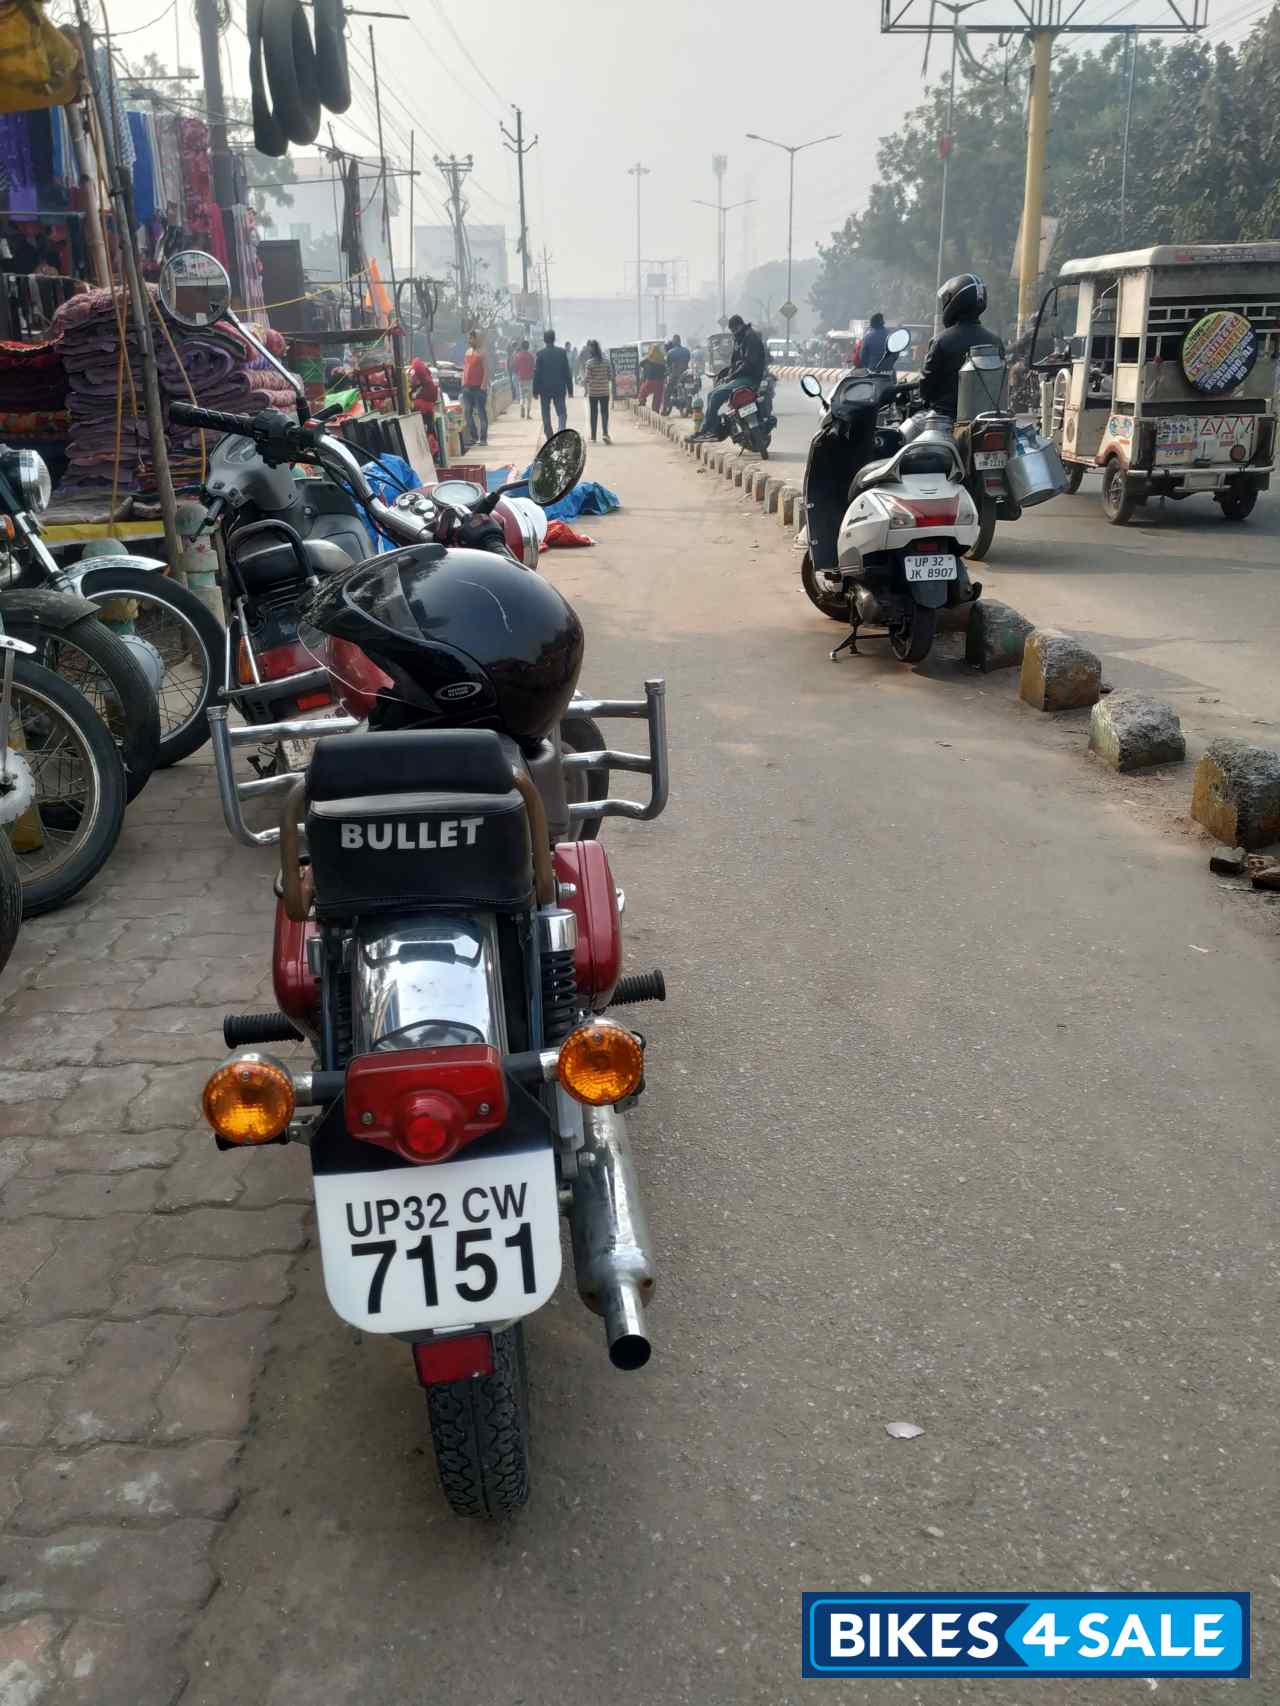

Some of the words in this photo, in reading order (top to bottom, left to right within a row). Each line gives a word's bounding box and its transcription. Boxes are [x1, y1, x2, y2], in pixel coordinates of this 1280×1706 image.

[910, 569, 922, 580] JK
[927, 567, 953, 578] 8907
[914, 557, 928, 568] UP
[931, 556, 944, 567] 32
[341, 817, 484, 850] BULLET
[346, 1193, 449, 1237] UP32
[462, 1182, 528, 1223] CW
[351, 1222, 537, 1315] 7151
